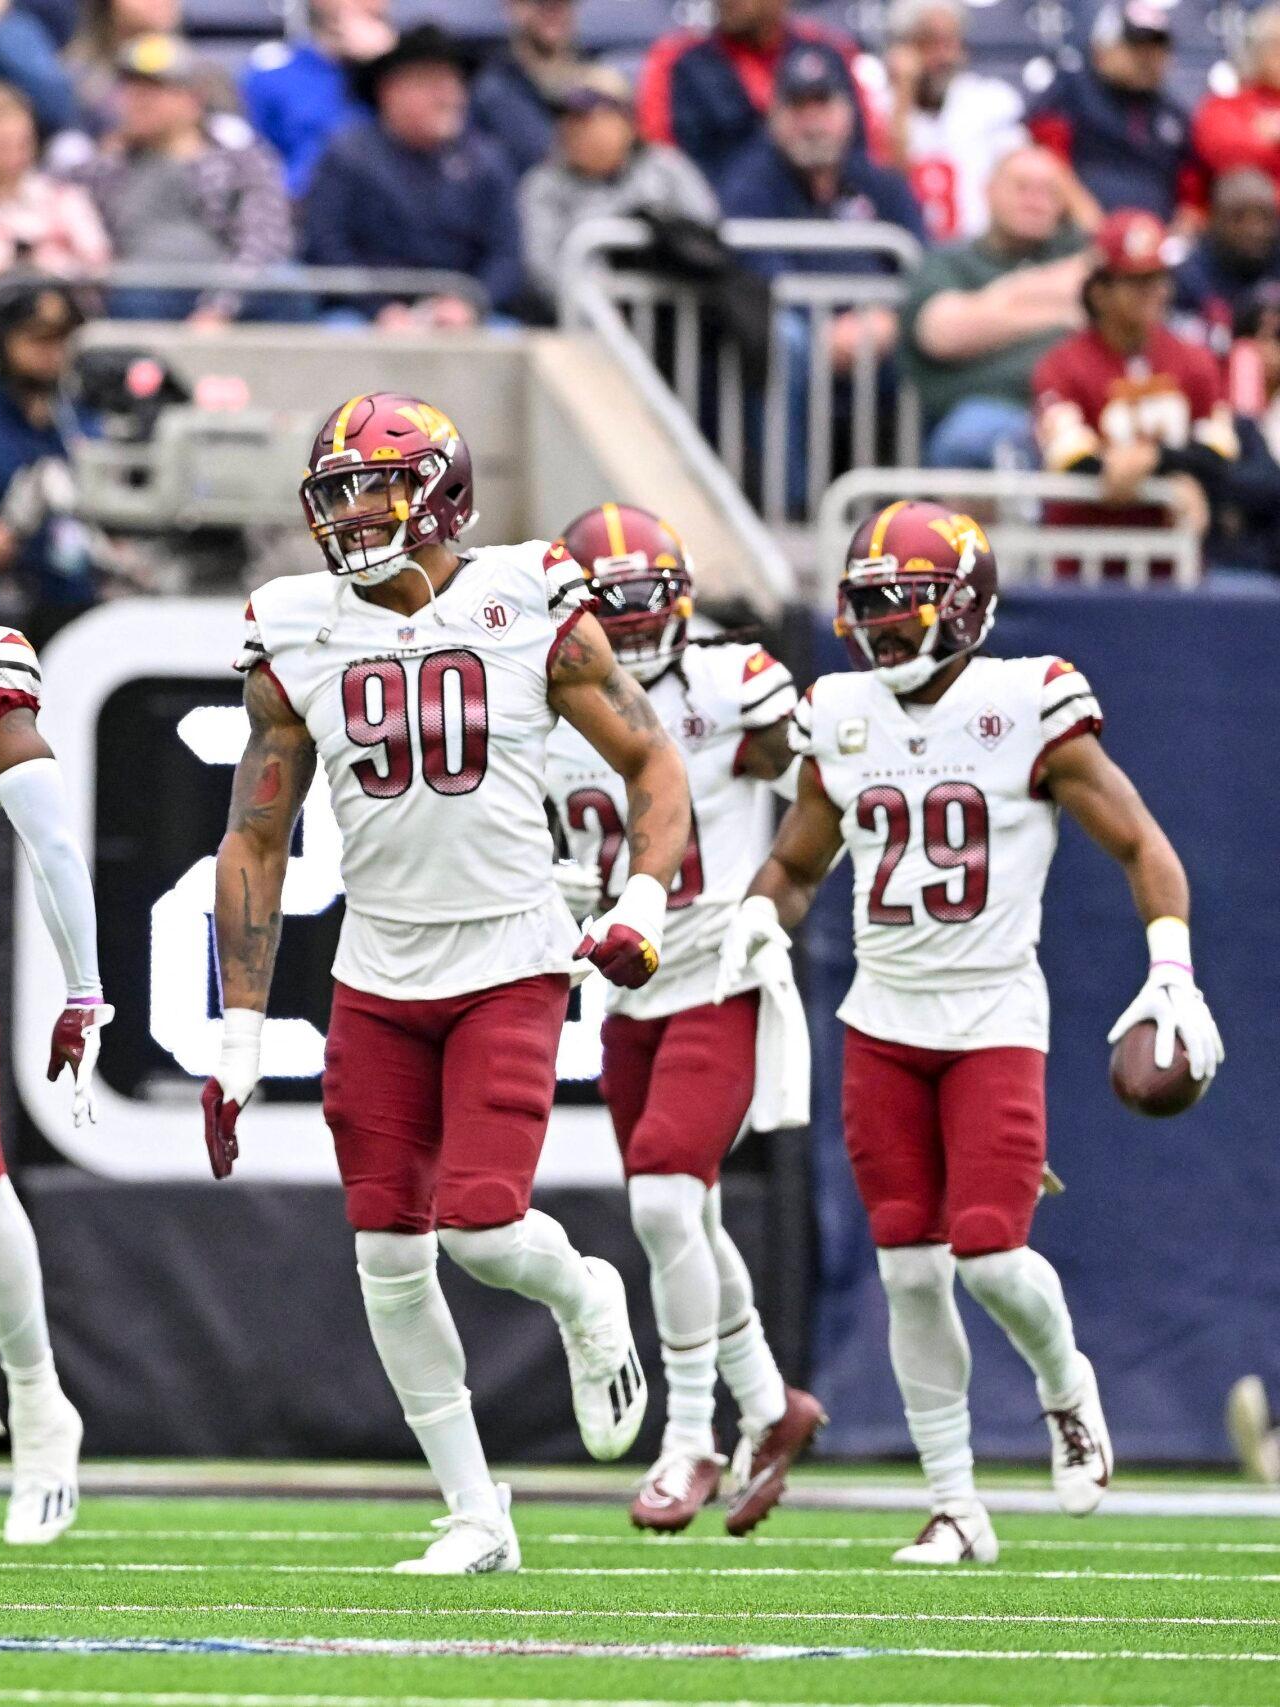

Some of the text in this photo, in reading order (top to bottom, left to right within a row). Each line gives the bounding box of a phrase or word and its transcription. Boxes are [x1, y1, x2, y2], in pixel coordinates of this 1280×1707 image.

[483, 604, 507, 629] 90
[345, 648, 489, 800] 90
[979, 715, 1001, 738] 90
[856, 780, 990, 926] 29
